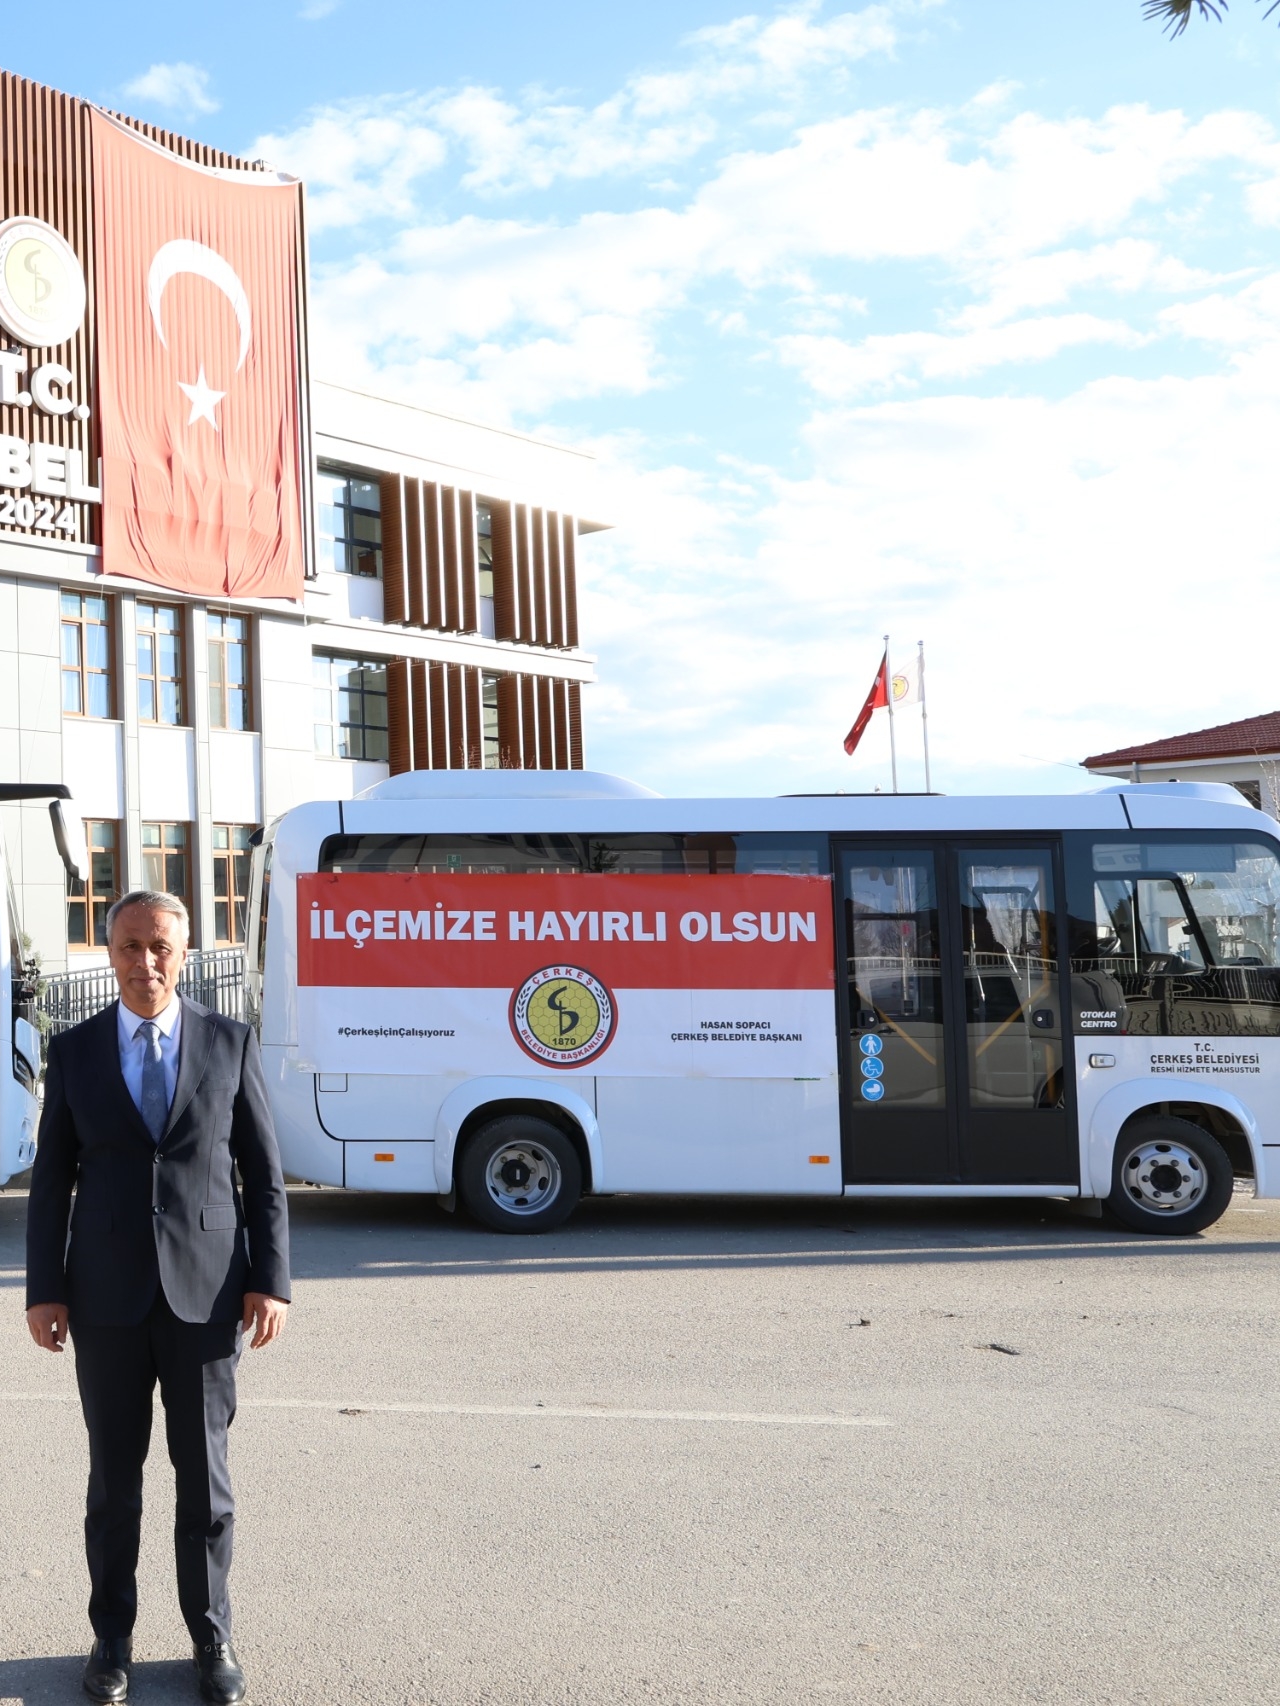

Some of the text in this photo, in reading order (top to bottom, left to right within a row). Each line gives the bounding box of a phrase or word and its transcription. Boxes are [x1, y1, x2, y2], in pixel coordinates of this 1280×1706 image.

[310, 901, 817, 949] İLÇEMİZE HAYIRLI OLSUN
[532, 968, 594, 987] ÇERKEŞ
[1080, 1011, 1117, 1019] OTOKAR
[700, 1021, 771, 1030] HASAN SOPACI
[1080, 1020, 1118, 1028] CENTRO
[338, 1025, 455, 1038] #ÇerkeşİçinÇalışıyoruz
[552, 1037, 577, 1046] 1870
[671, 1031, 803, 1043] ÇERKEŞ BELEDİYE BAŞKANI
[520, 1029, 606, 1060] BELEDİYE BAŞKANLIĞI
[1194, 1043, 1215, 1052] T.C.
[1150, 1053, 1260, 1065] ÇERKEŞ BELEDİYESİ
[1151, 1066, 1261, 1074] RESMİ HİZMETE MAHSUSTUR
